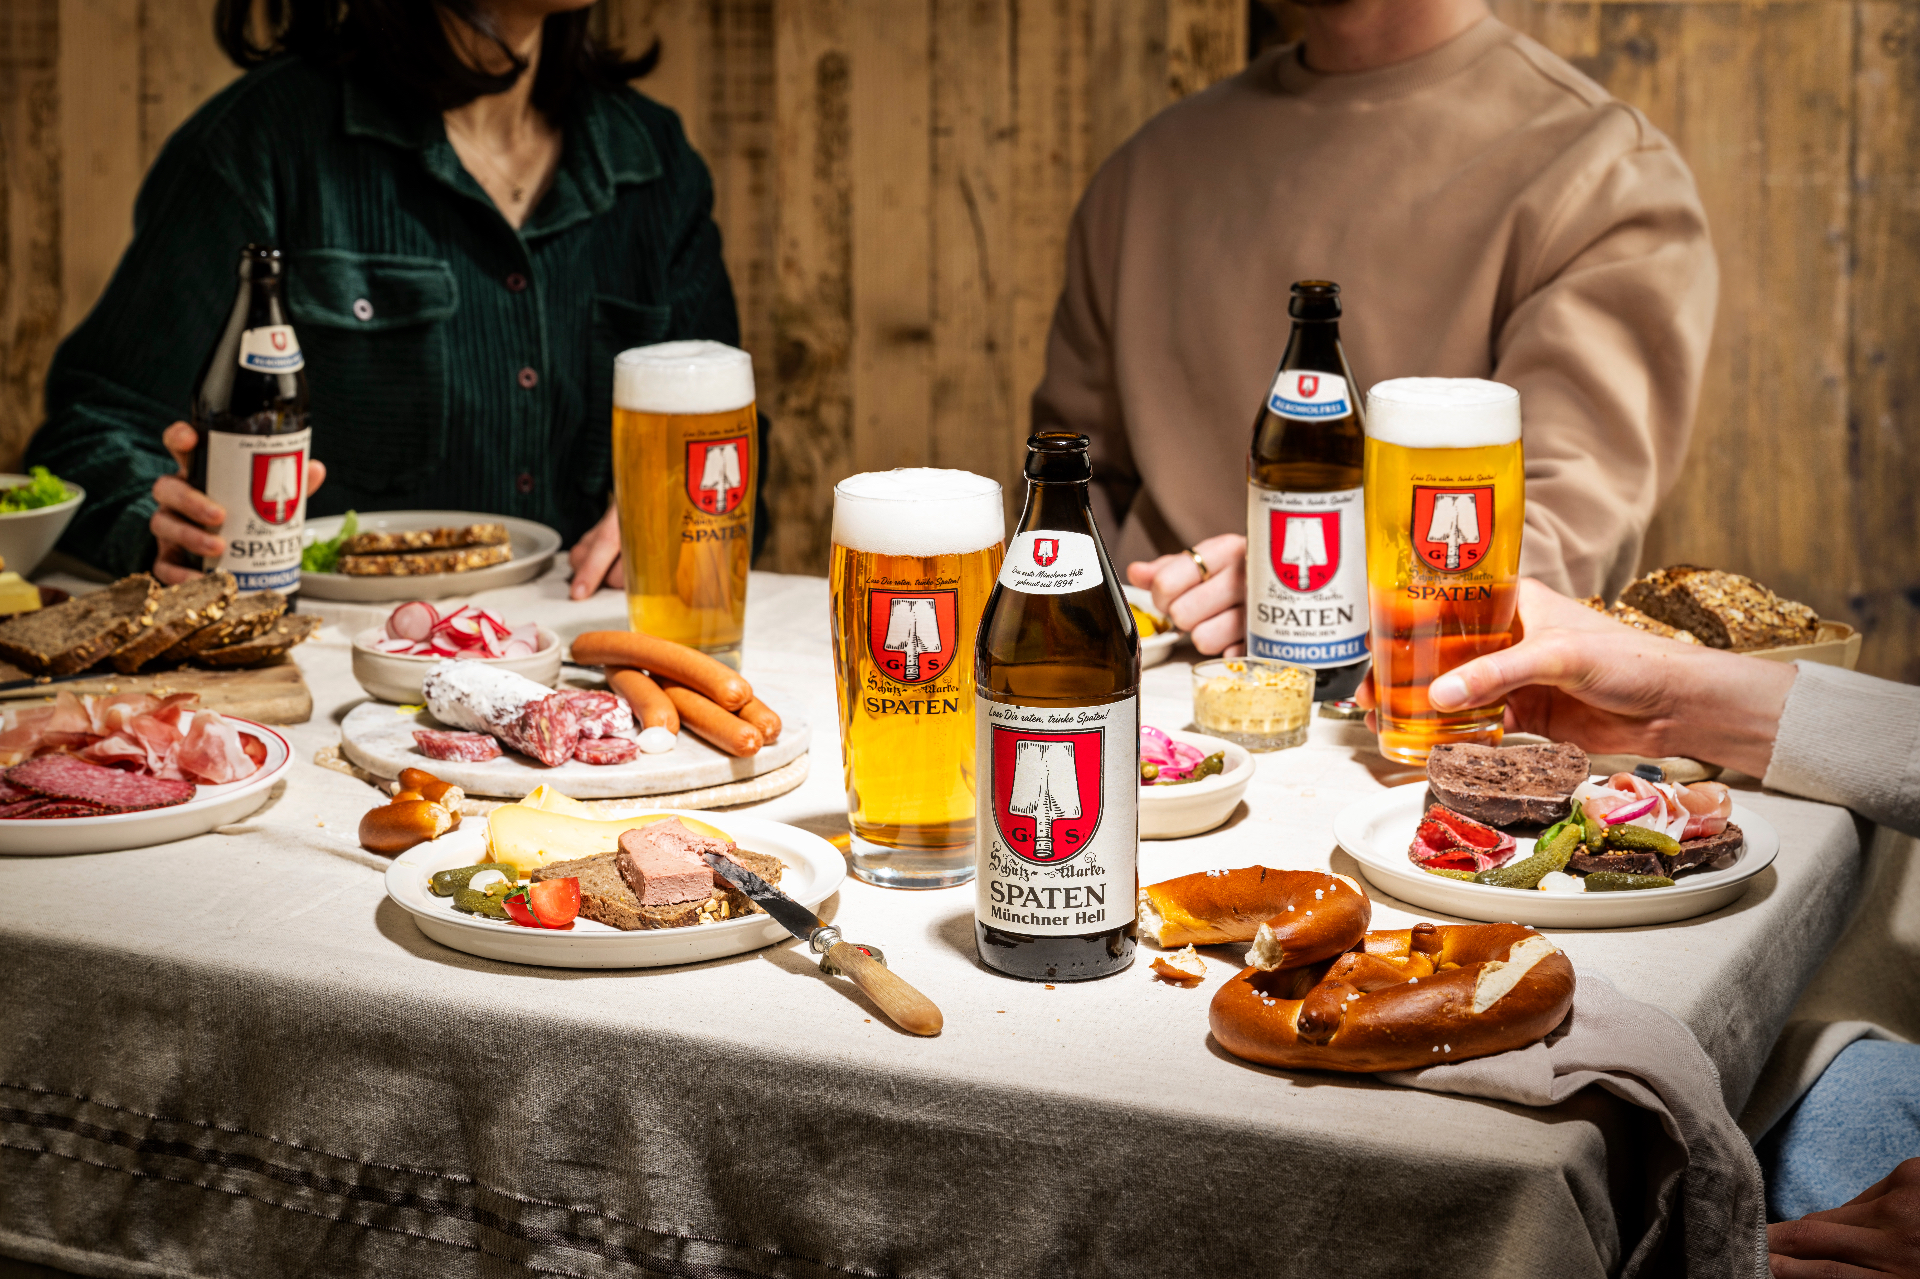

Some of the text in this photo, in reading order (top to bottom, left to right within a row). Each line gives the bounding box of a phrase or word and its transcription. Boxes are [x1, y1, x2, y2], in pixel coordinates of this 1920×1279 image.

[682, 525, 747, 543] SPATEN
[1428, 549, 1477, 560] G S
[1407, 584, 1493, 601] SPATEN
[1257, 603, 1354, 627] SPATEN
[1256, 641, 1360, 660] ALKOHOLFREI
[886, 660, 940, 670] G S
[867, 697, 959, 715] SPATEN
[1004, 709, 1019, 721] Dir
[1021, 713, 1044, 723] raten,
[1048, 712, 1074, 724] trinke
[1077, 708, 1111, 725] Spaten!
[1012, 828, 1081, 844] G S
[991, 880, 1107, 910] SPATEN
[991, 905, 1106, 926] Münchner Hell
